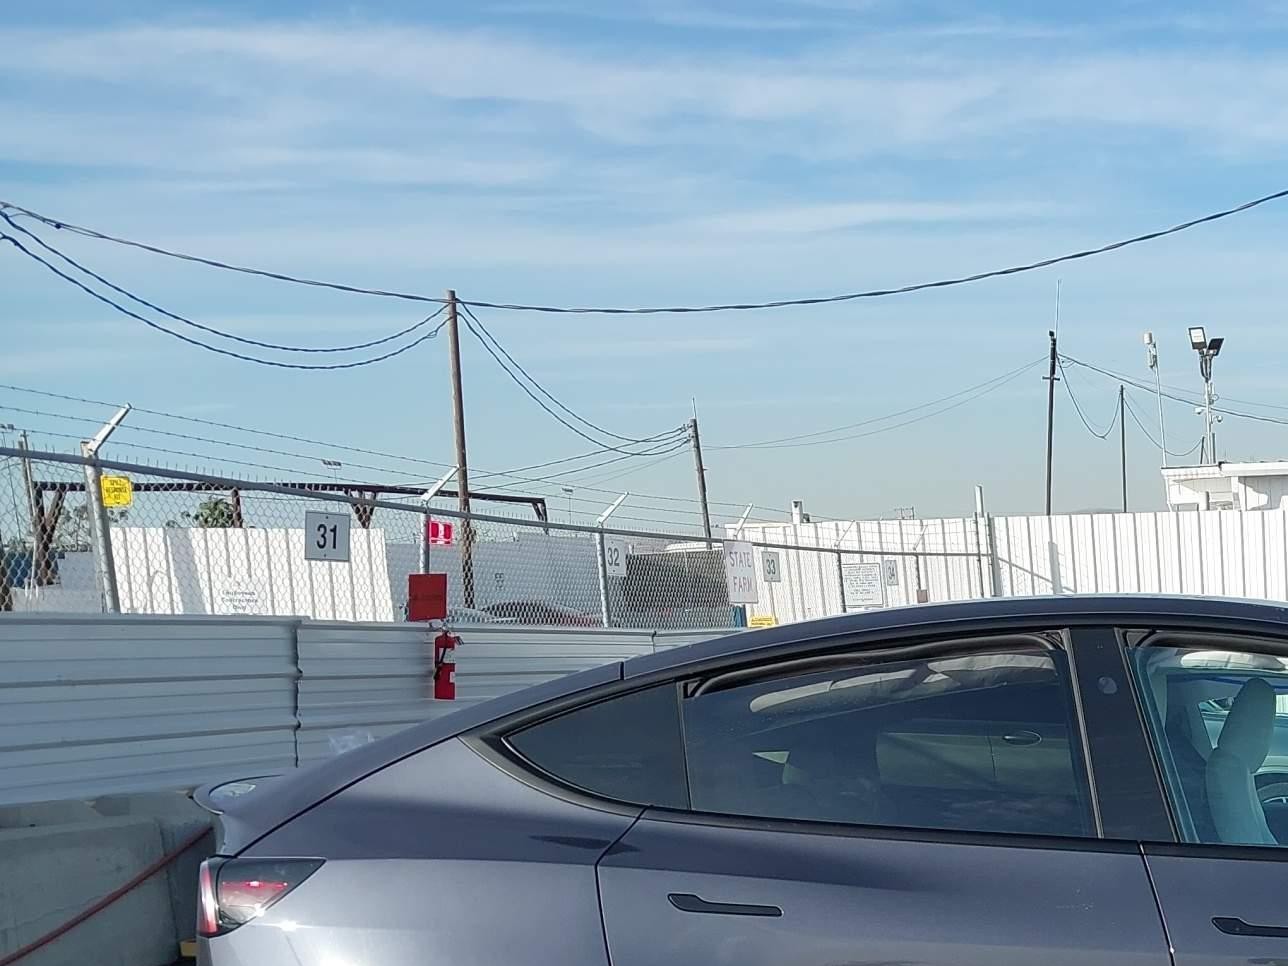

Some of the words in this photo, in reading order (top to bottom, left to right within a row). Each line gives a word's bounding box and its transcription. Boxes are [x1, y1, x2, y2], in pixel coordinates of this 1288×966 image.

[316, 523, 337, 550] 31
[607, 547, 620, 567] 32
[729, 551, 752, 568] STATE
[766, 559, 776, 575] 33
[733, 576, 752, 593] FARM
